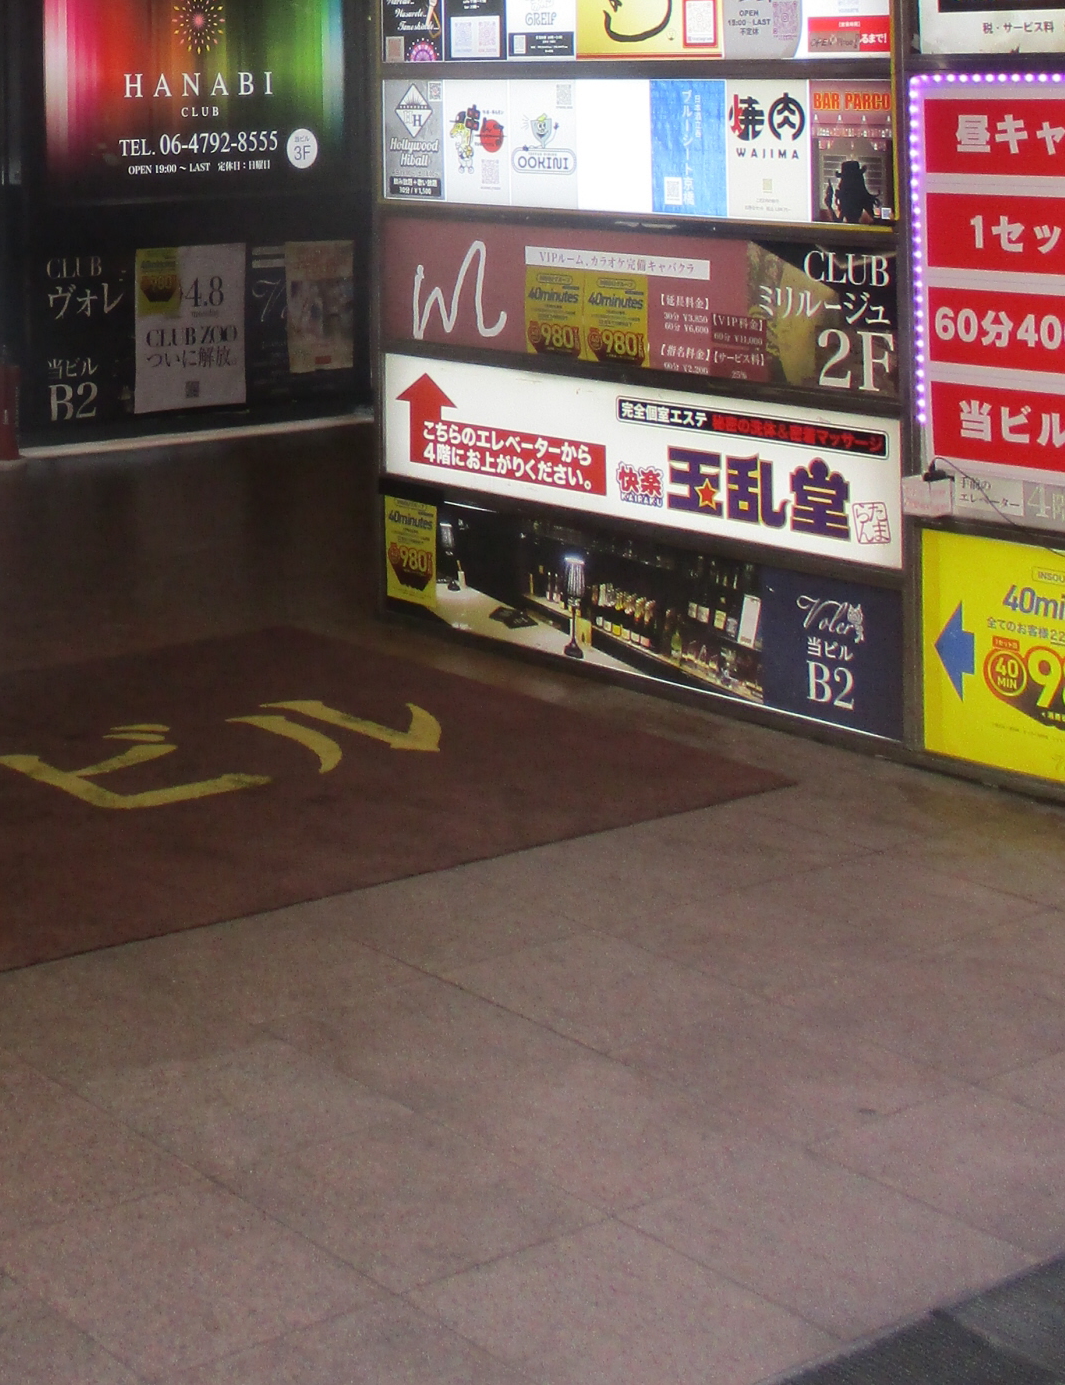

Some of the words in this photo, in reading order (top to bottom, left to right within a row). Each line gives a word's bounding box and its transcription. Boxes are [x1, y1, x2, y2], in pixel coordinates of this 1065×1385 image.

[739, 9, 759, 17] OPEN
[122, 71, 274, 99] HANABI
[181, 106, 220, 118] CLUB
[813, 92, 840, 110] BAR
[844, 92, 891, 111] PARCO
[728, 92, 806, 141] 焼肉
[119, 138, 155, 157] TEL.
[159, 130, 278, 156] 06-4792-8555
[294, 145, 311, 161] 3F
[390, 137, 439, 153] Hollywood
[682, 89, 695, 206] ブルーシート京橋
[736, 147, 800, 160] WAJIMA
[128, 164, 152, 175] OPEN
[155, 163, 177, 173] 19:00
[189, 162, 211, 173] LAST
[400, 153, 429, 167] Hiball
[517, 156, 568, 170] OOKINI
[46, 256, 103, 279] CLUB
[803, 250, 890, 287] CLUB
[47, 282, 124, 320] ヴォレ
[185, 275, 224, 308] 4.8
[528, 287, 580, 303] 40minutes
[588, 292, 644, 310] 40minutes
[759, 285, 891, 325] ミリルージュ
[146, 325, 196, 348] CLUB
[541, 322, 574, 349] 980
[601, 329, 638, 357] 980
[47, 357, 98, 380] 当ビル
[817, 328, 895, 392] 2F
[49, 381, 98, 422] B2
[621, 401, 708, 429] 完全個室エステ
[423, 420, 593, 467] こちらのエレベーターから
[423, 442, 593, 491] 4階にお上がりください。
[618, 462, 664, 496] 快楽
[620, 493, 664, 508] KAIRAKU
[399, 545, 428, 573] 980
[995, 656, 1019, 679] 40
[806, 659, 855, 711] B2
[997, 675, 1018, 691] MIN
